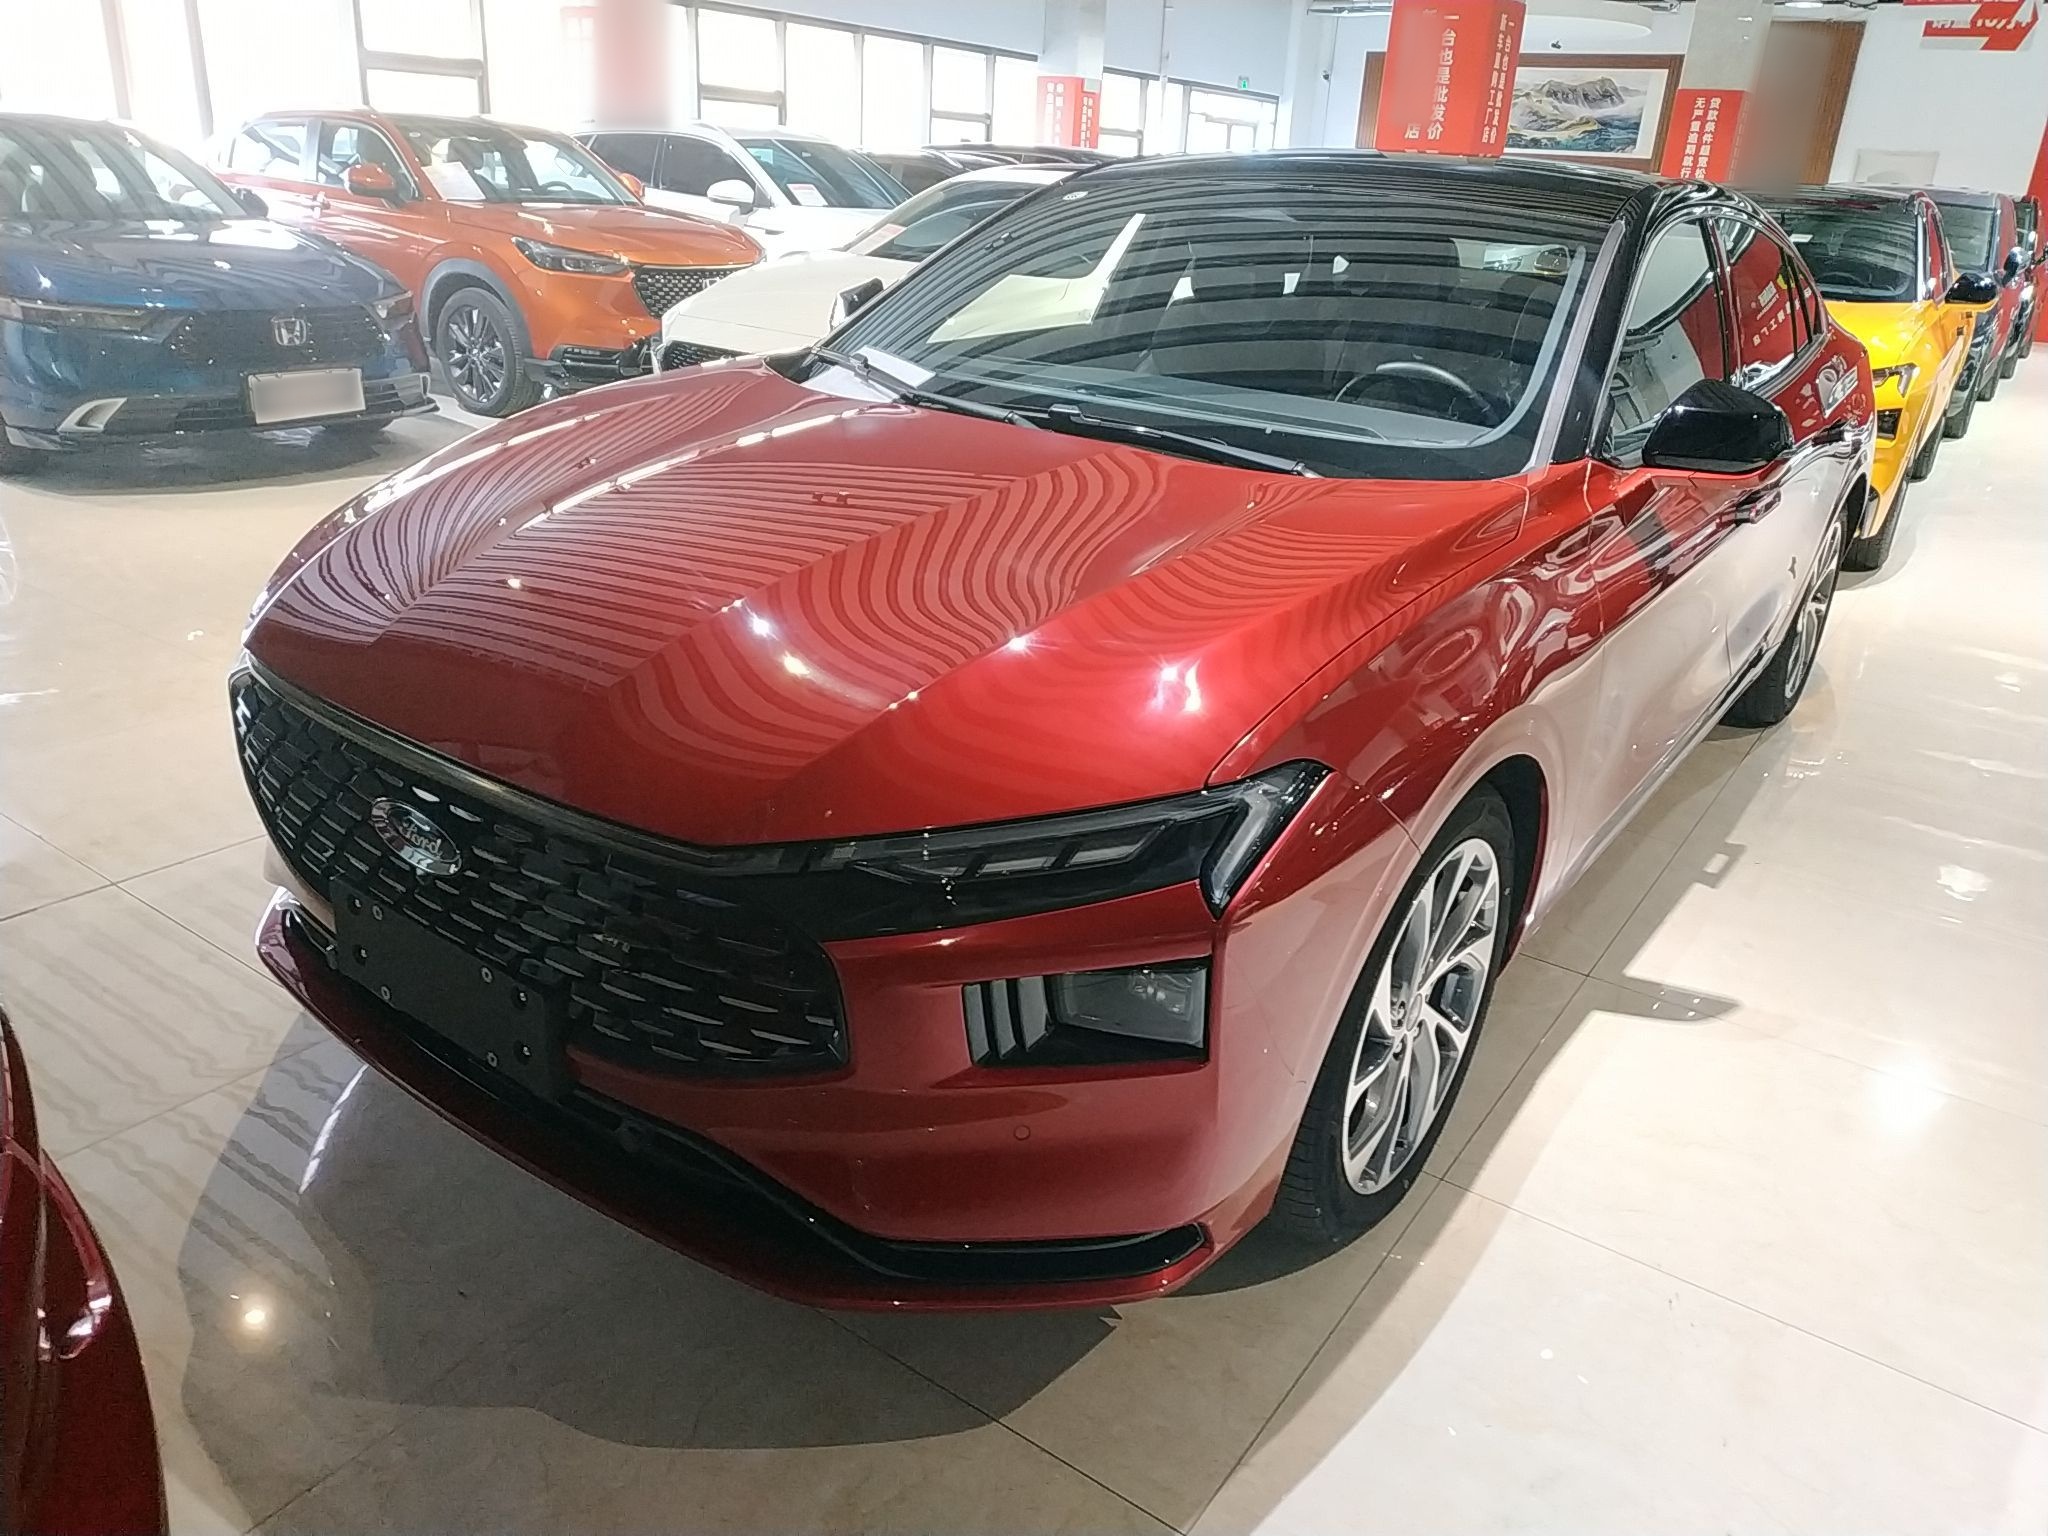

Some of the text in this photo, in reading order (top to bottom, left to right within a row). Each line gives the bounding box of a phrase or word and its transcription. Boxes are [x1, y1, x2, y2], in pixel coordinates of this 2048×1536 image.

[1427, 15, 1460, 140] 一台也是批发价
[400, 817, 442, 855] Ford
